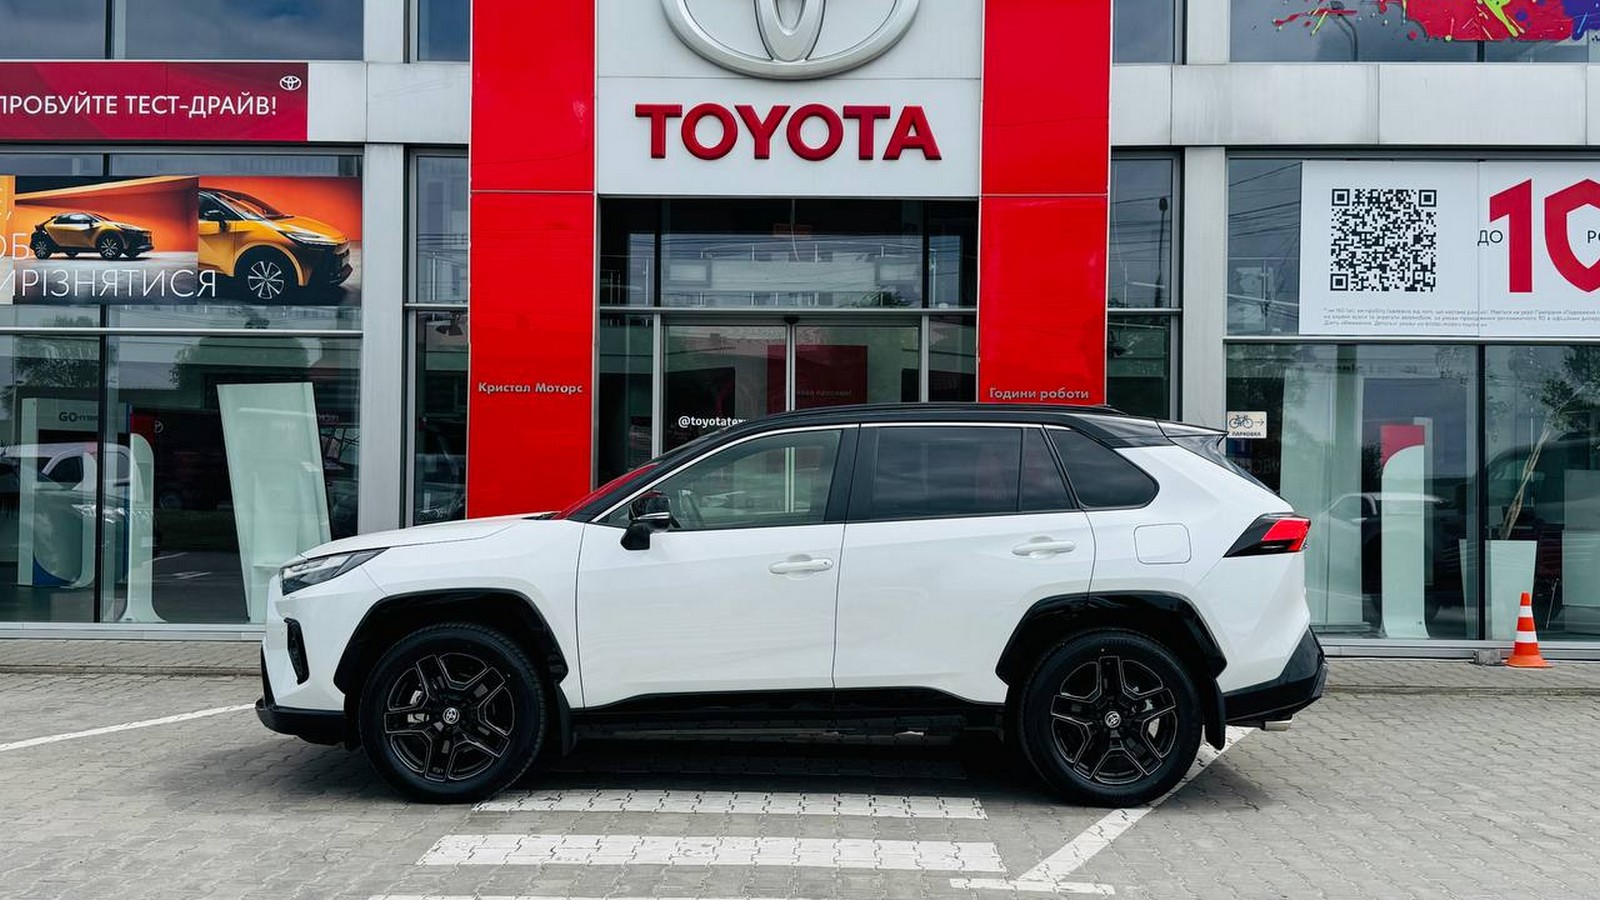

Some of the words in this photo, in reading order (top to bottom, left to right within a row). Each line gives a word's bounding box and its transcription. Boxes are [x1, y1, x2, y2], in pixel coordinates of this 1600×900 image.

[125, 92, 277, 119] ТЕСТ-ДРАЙВ!
[635, 103, 942, 161] TOYOTA
[1477, 230, 1503, 246] ДО
[1587, 230, 1600, 244] Р
[0, 232, 30, 261] Б
[478, 382, 531, 394] Кристал
[535, 382, 583, 395] Моторс
[989, 387, 1036, 400] Години
[1040, 387, 1089, 401] роботи
[678, 415, 747, 428] @toyotate
